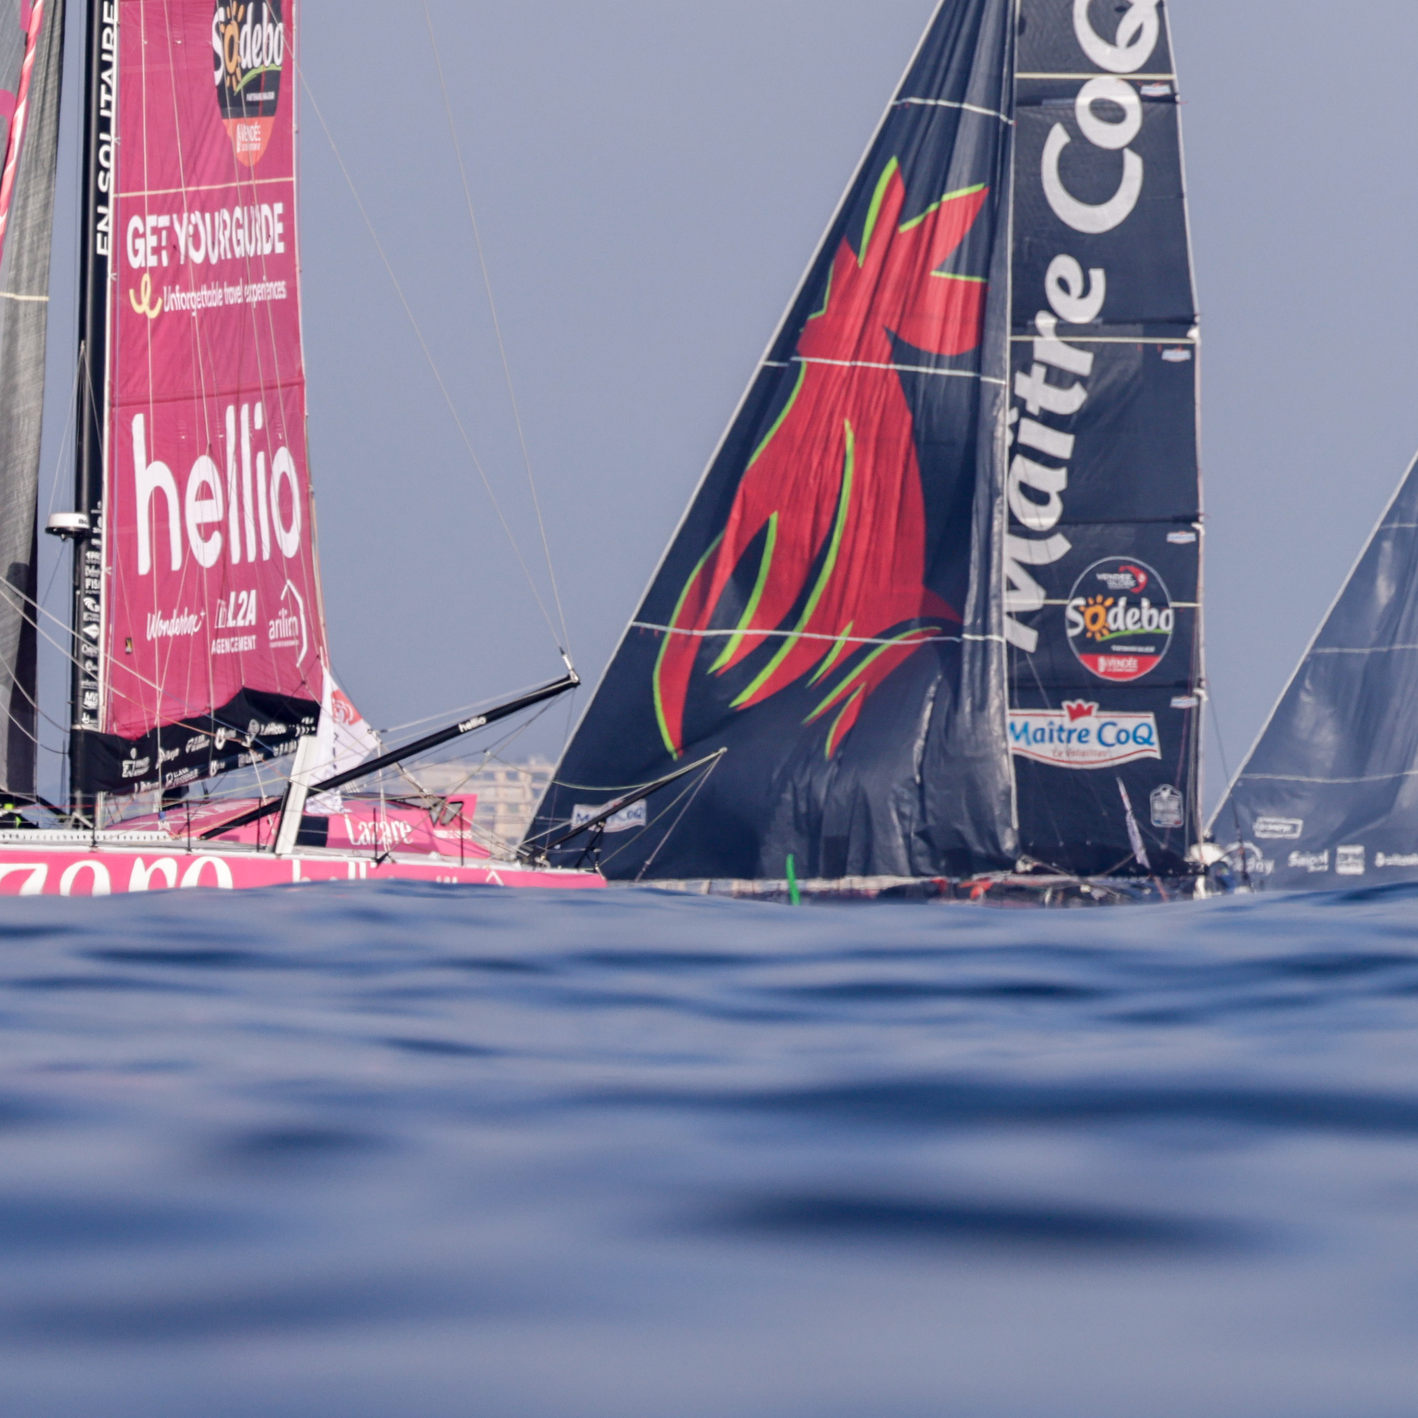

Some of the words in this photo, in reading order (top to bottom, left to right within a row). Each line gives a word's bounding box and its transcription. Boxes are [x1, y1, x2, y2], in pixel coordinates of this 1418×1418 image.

[212, 1, 284, 87] Sodebo
[163, 281, 223, 316] Unforgettable
[224, 278, 244, 304] travel
[245, 276, 287, 308] experiences
[132, 401, 302, 576] hellio
[227, 589, 257, 628] L2A
[1066, 596, 1175, 638] Sodebo
[211, 635, 257, 655] AGENCEMENT
[1097, 720, 1156, 747] CoQ
[344, 813, 413, 846] Lazare
